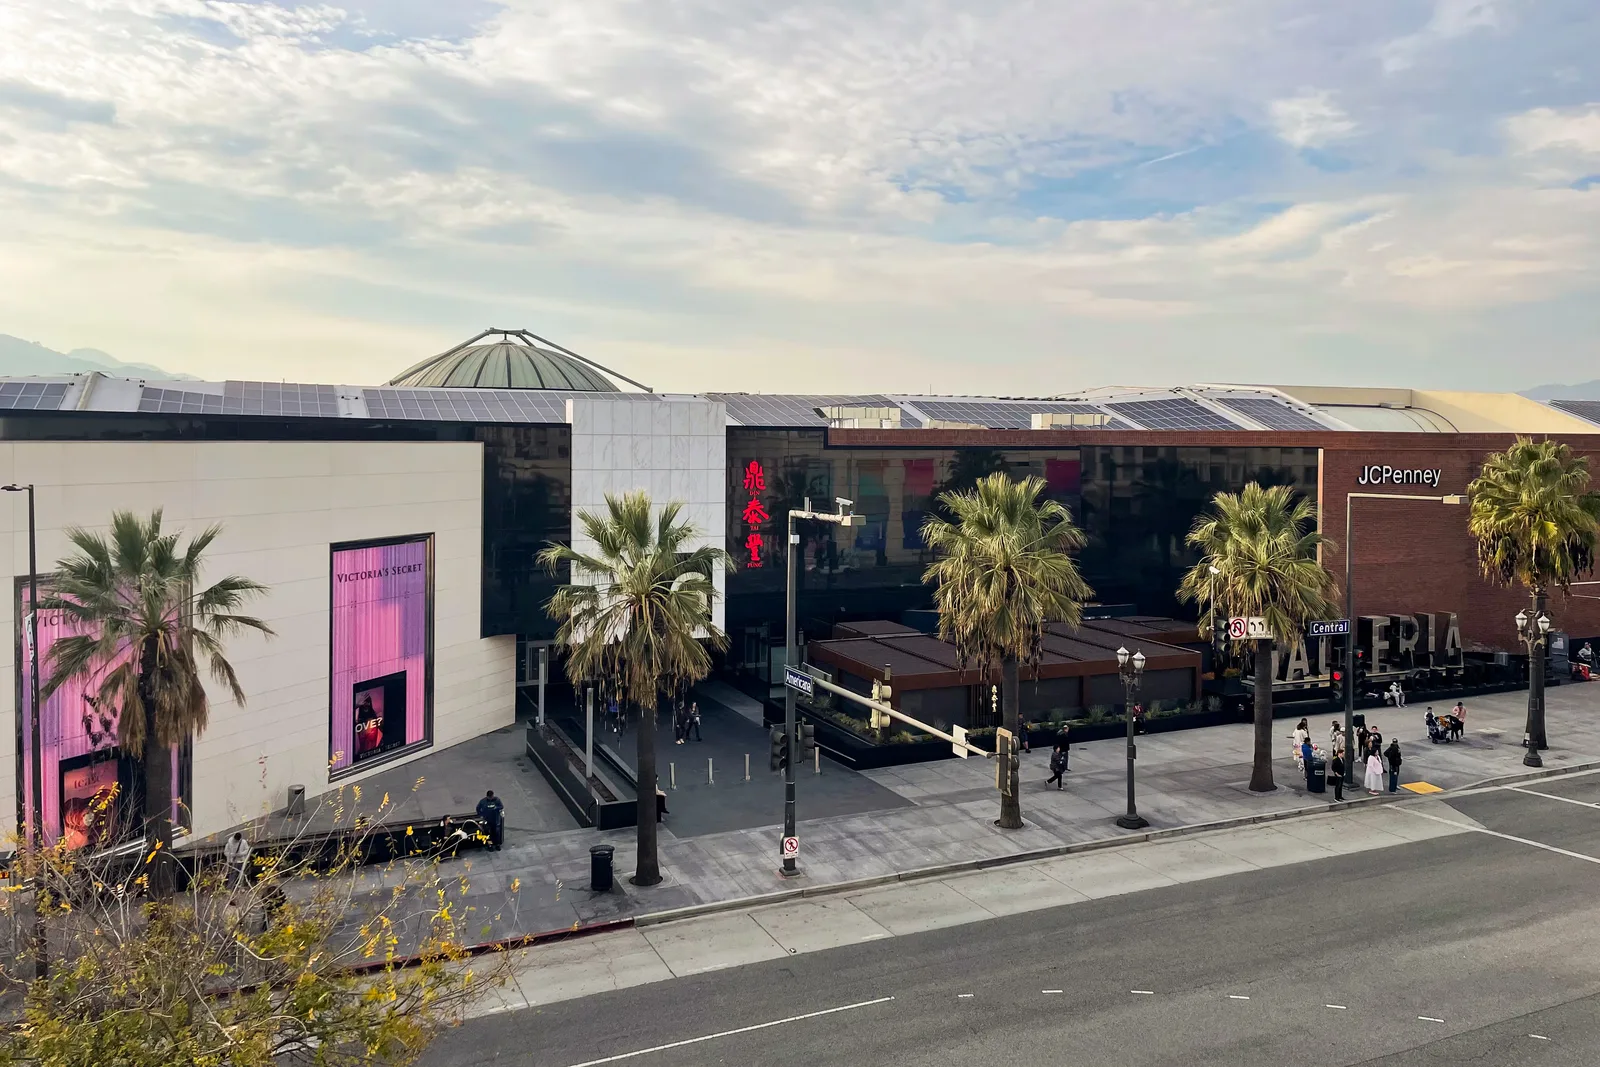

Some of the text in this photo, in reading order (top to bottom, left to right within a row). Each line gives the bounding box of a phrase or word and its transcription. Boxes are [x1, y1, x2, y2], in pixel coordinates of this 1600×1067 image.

[1358, 465, 1441, 487] JCPenney
[337, 563, 422, 583] VICTORIA'S SECRET
[1313, 622, 1347, 633] Central
[355, 717, 383, 733] OVE?
